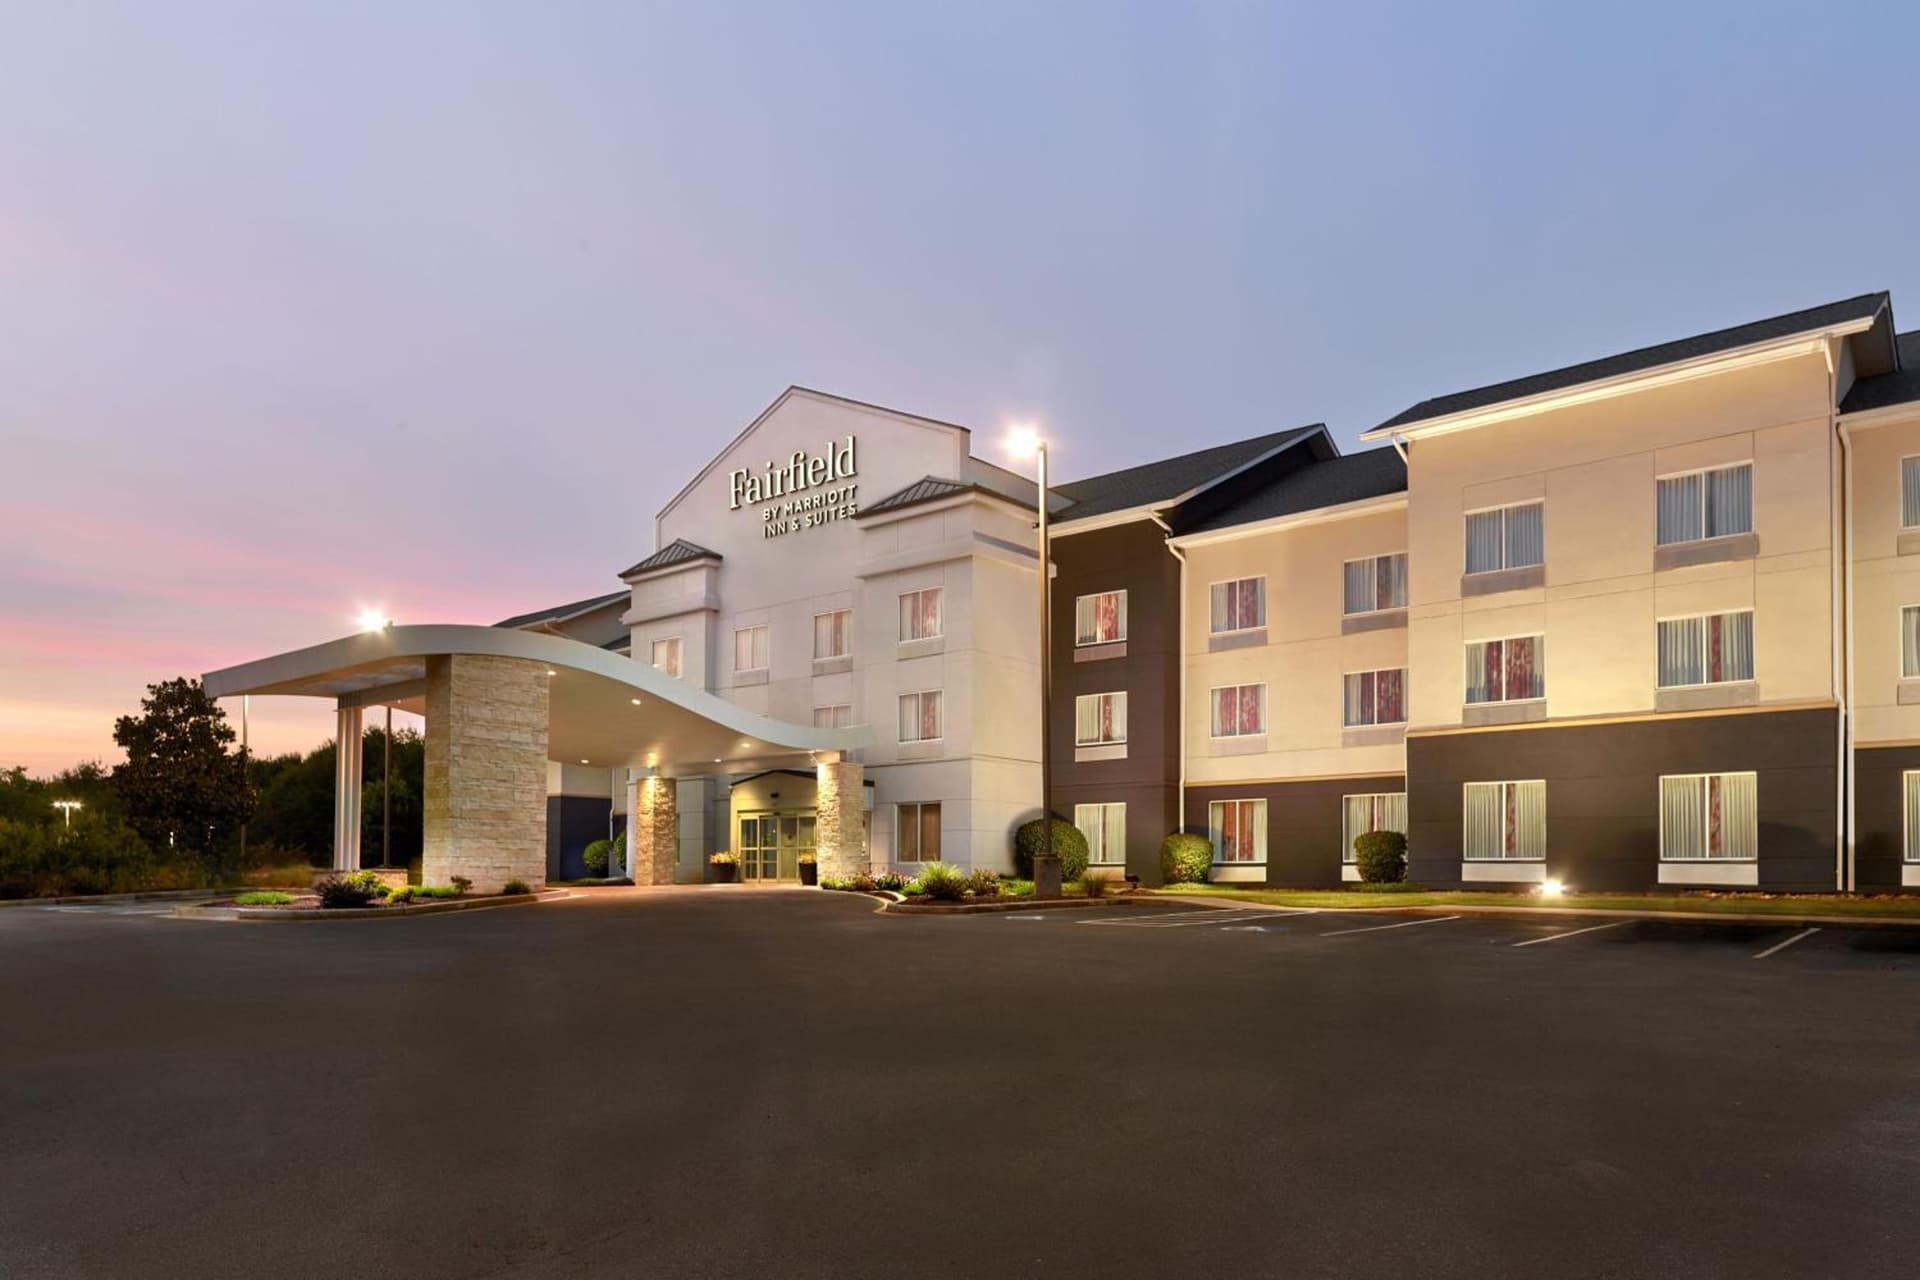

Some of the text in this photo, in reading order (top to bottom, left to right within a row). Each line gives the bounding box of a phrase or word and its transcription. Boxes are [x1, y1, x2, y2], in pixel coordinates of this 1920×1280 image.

[729, 435, 857, 510] Fairfield
[763, 485, 857, 522] BY MARRIOTT
[764, 503, 857, 538] INN & SUITES
